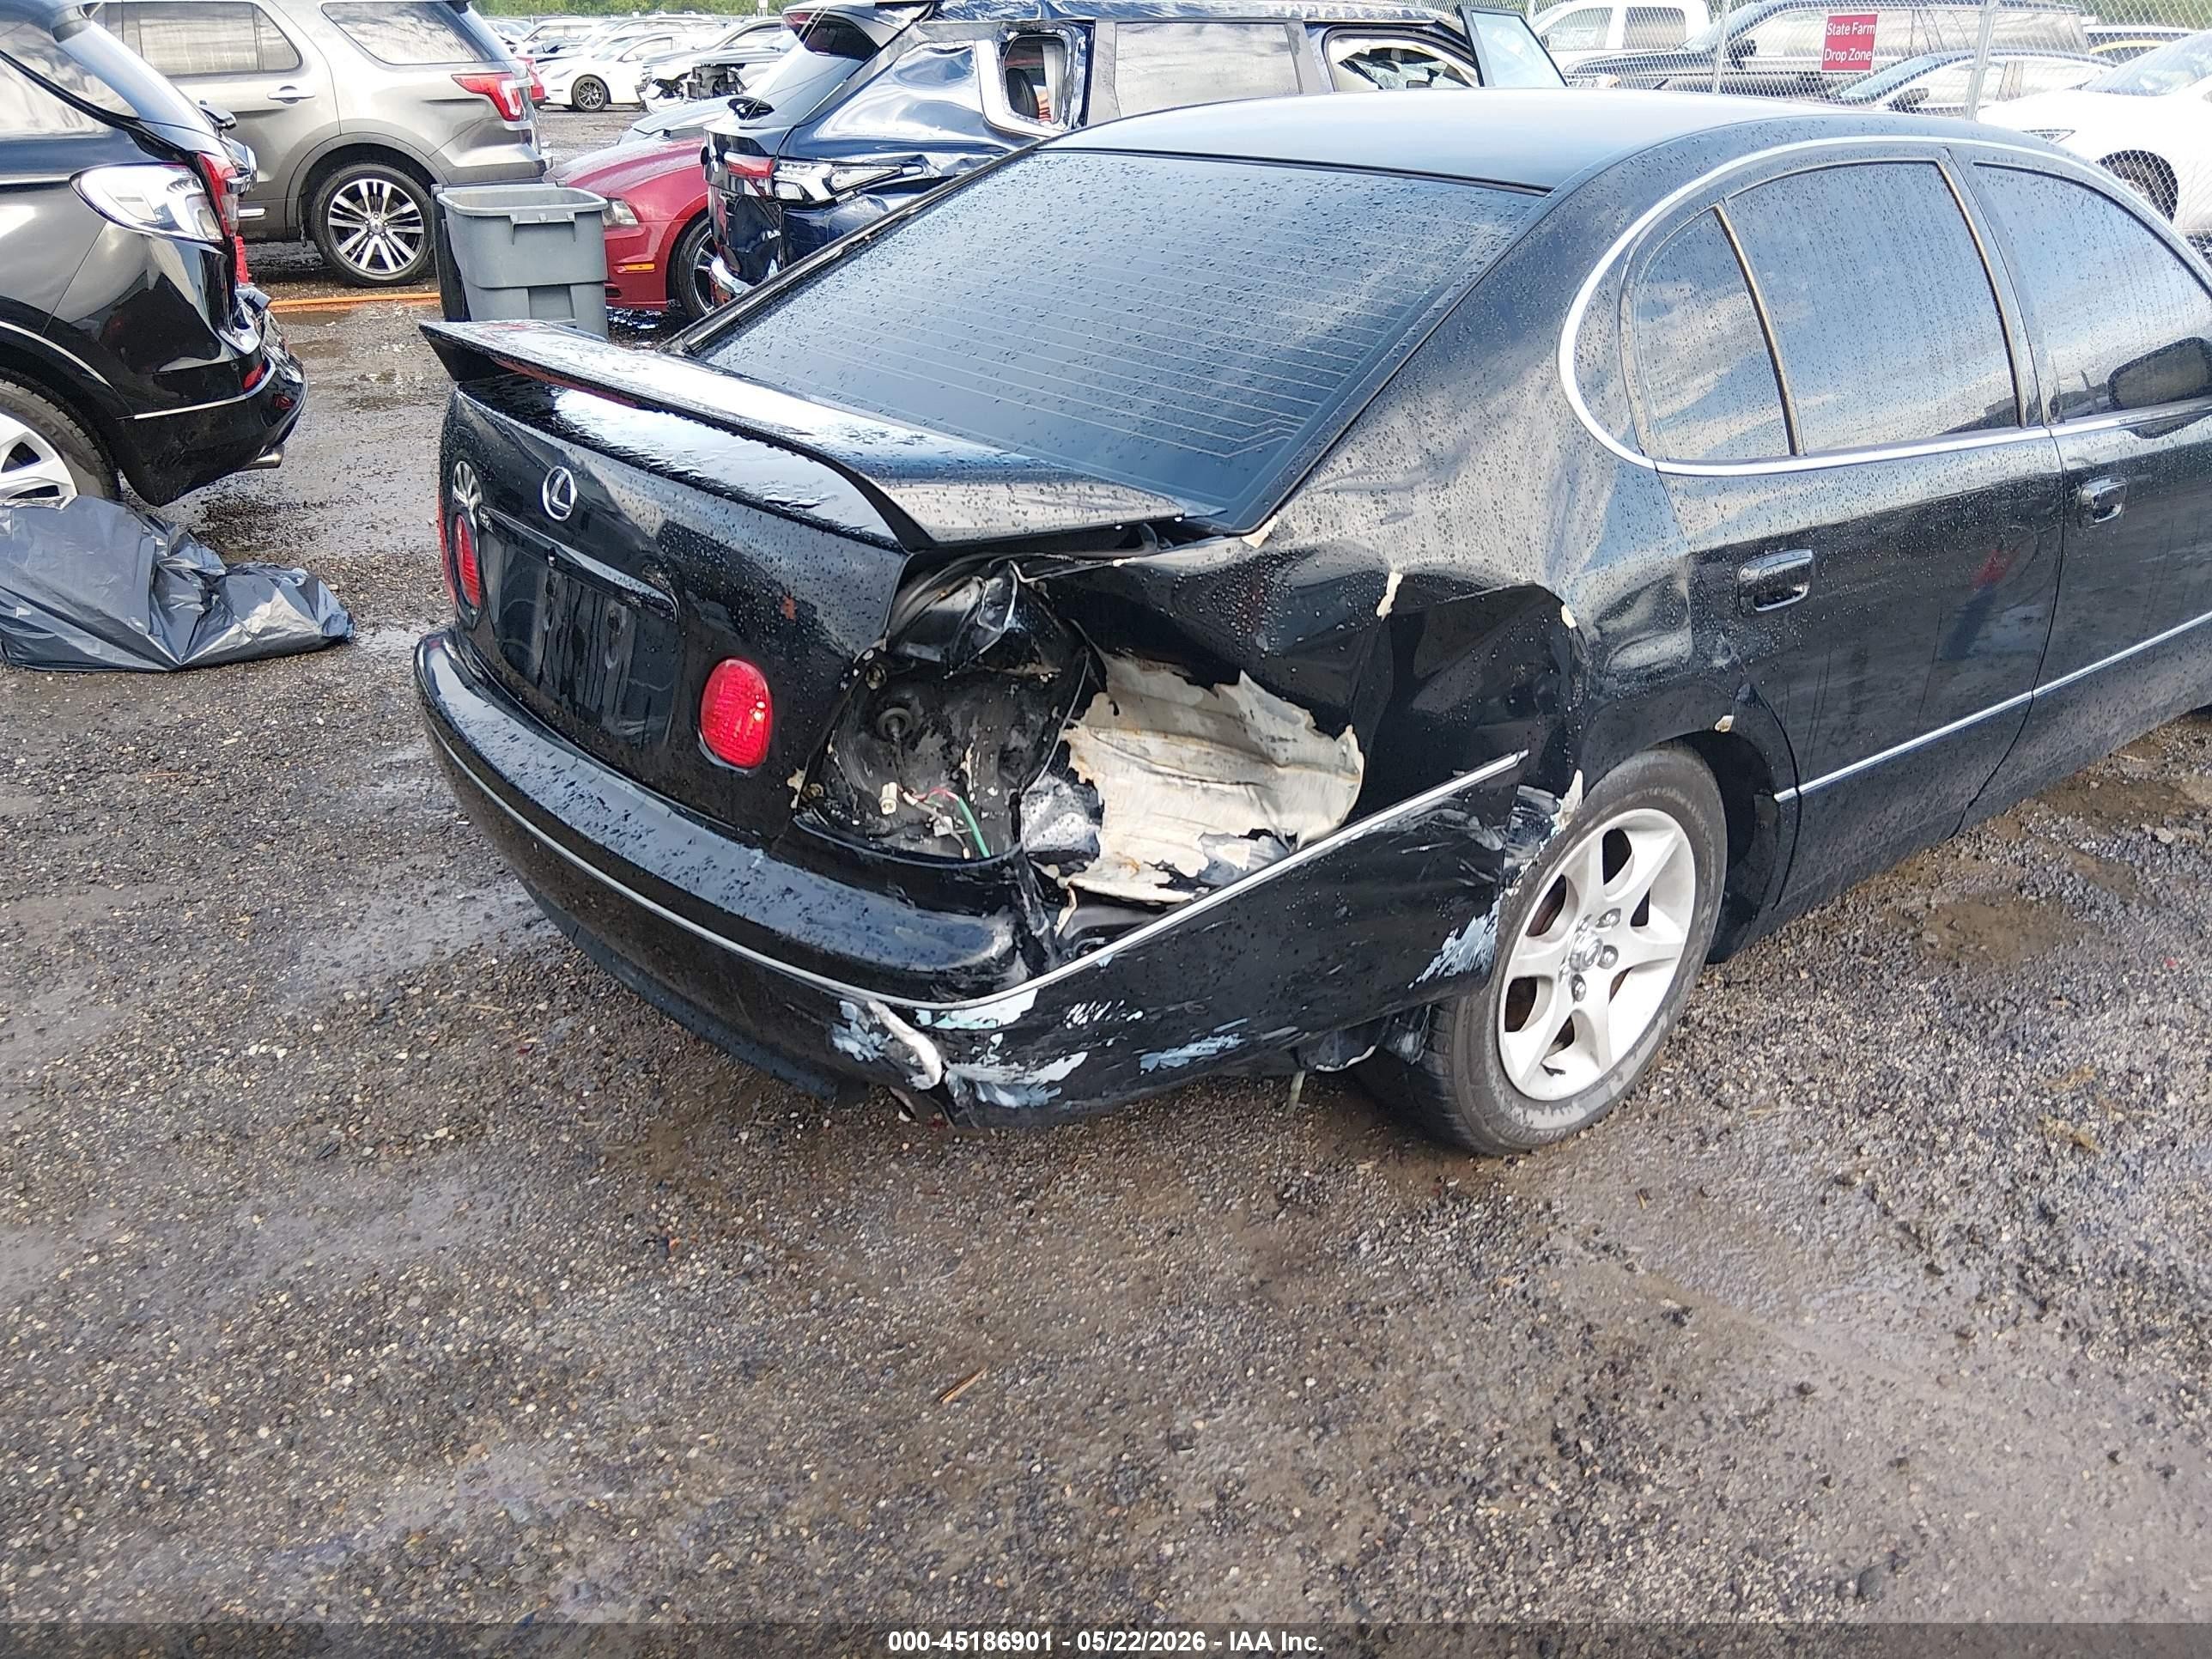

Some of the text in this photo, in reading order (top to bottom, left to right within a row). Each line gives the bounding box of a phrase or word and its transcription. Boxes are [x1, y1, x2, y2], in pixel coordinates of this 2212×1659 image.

[1826, 21, 1875, 36] State Farm
[1824, 48, 1872, 64] Drop Zone
